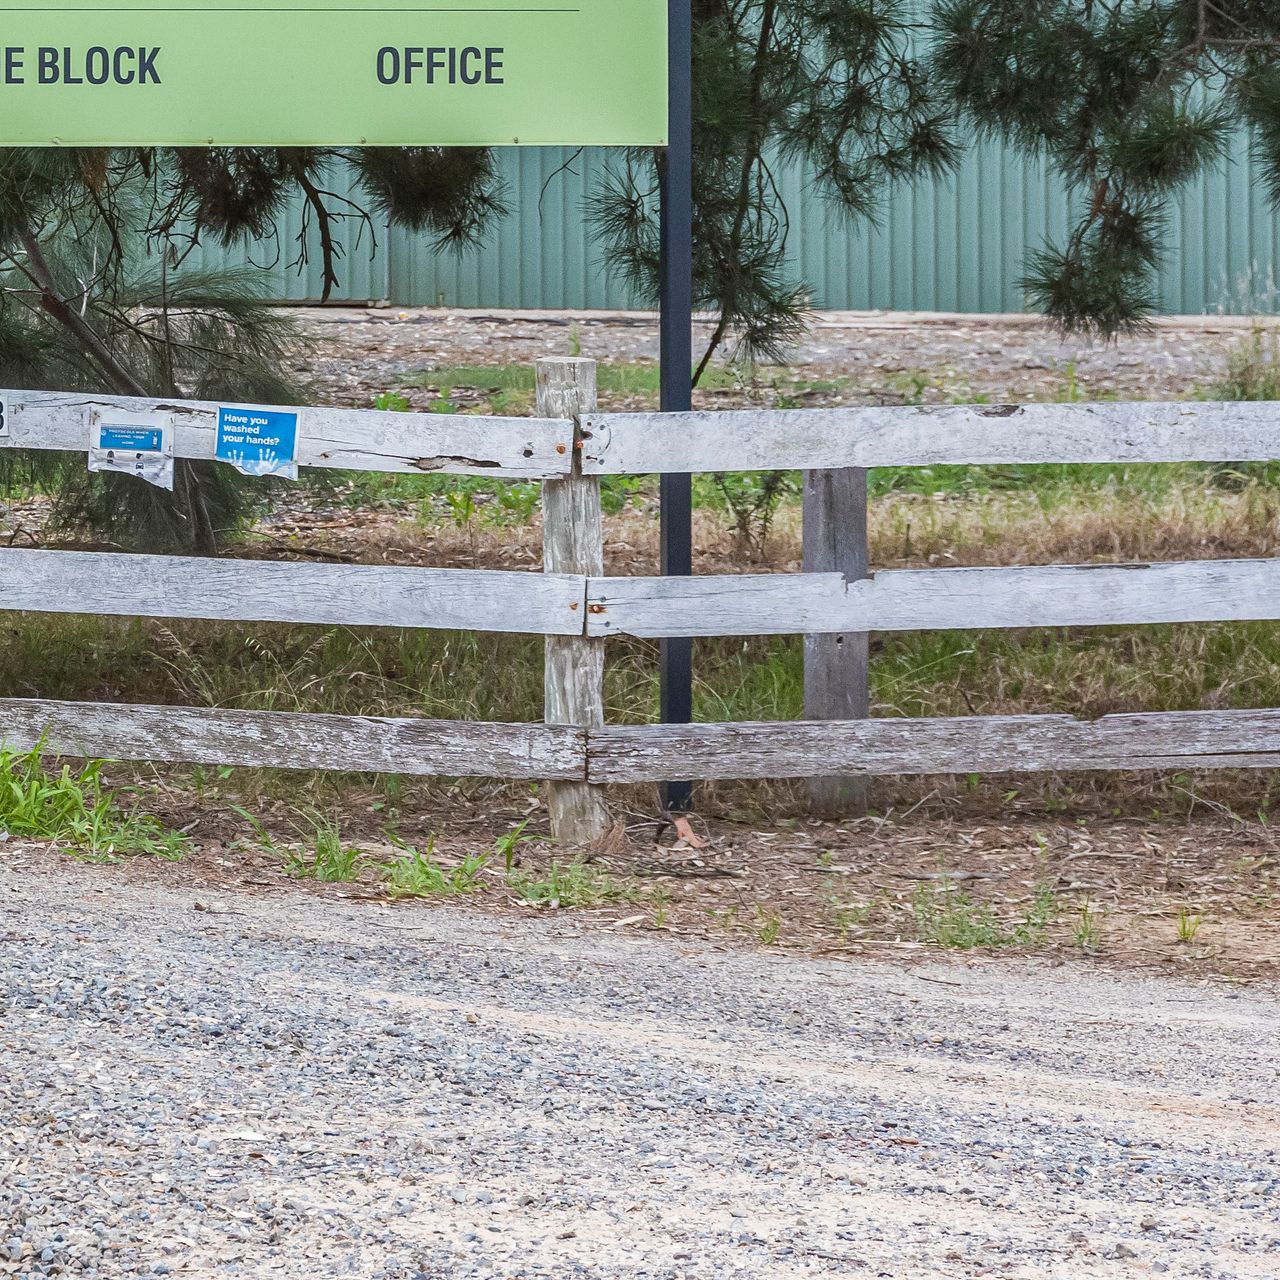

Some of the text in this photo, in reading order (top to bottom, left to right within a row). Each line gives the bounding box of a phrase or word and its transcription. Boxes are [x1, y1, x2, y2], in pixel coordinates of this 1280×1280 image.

[38, 46, 162, 85] BLOCK
[376, 46, 504, 85] OFFICE
[224, 413, 268, 425] Have you
[223, 424, 260, 434] washed
[222, 434, 280, 446] your hands?
